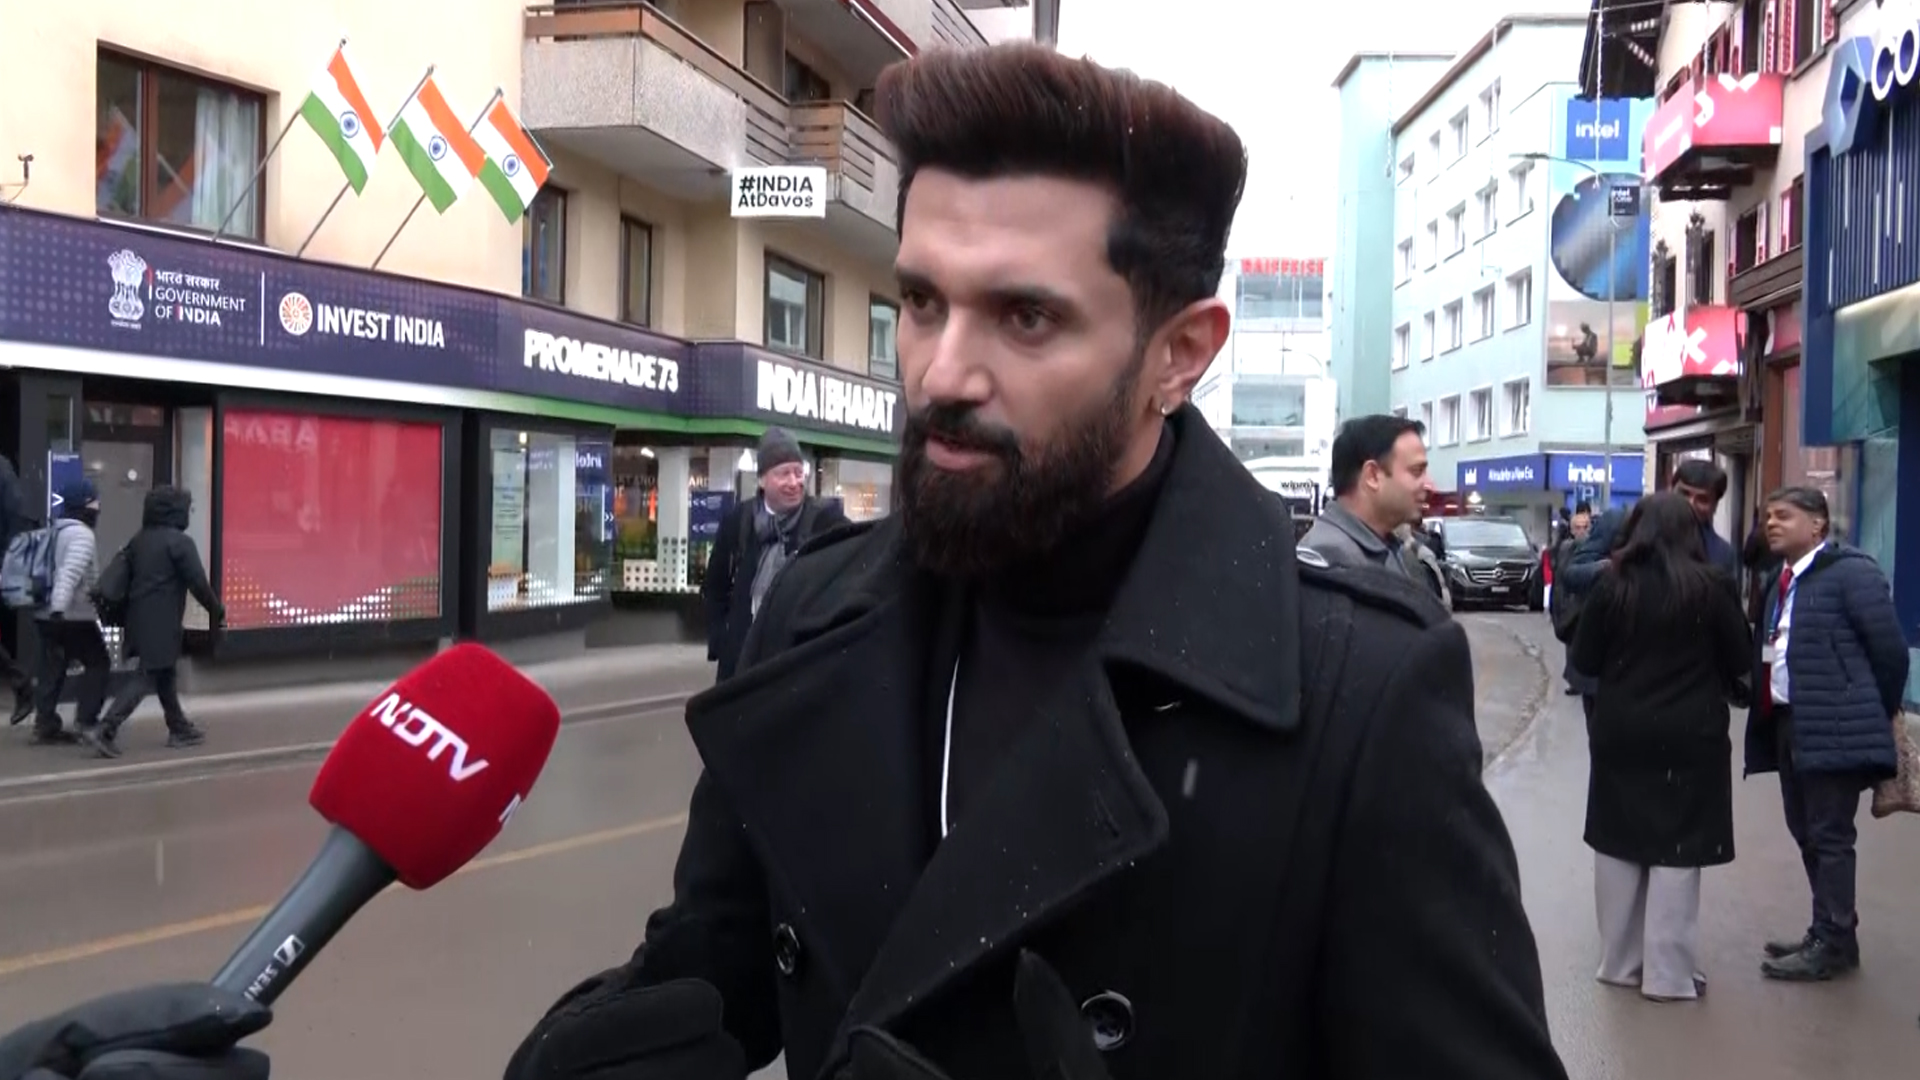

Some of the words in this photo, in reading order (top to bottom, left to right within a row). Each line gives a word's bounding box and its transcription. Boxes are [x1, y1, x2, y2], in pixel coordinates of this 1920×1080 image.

[1576, 119, 1619, 138] intel
[739, 175, 813, 193] #INDIA
[738, 193, 813, 208] AtDavos
[155, 287, 246, 311] GOVERNMENT
[155, 306, 173, 318] OF
[179, 305, 221, 326] INDIA
[317, 303, 391, 340] INVEST
[394, 314, 445, 348] INDIA
[524, 328, 656, 390] PROMENADE
[657, 357, 679, 393] 73
[757, 360, 818, 419] INDIA
[825, 377, 896, 434] BHARAT
[369, 692, 489, 781] NDTV
